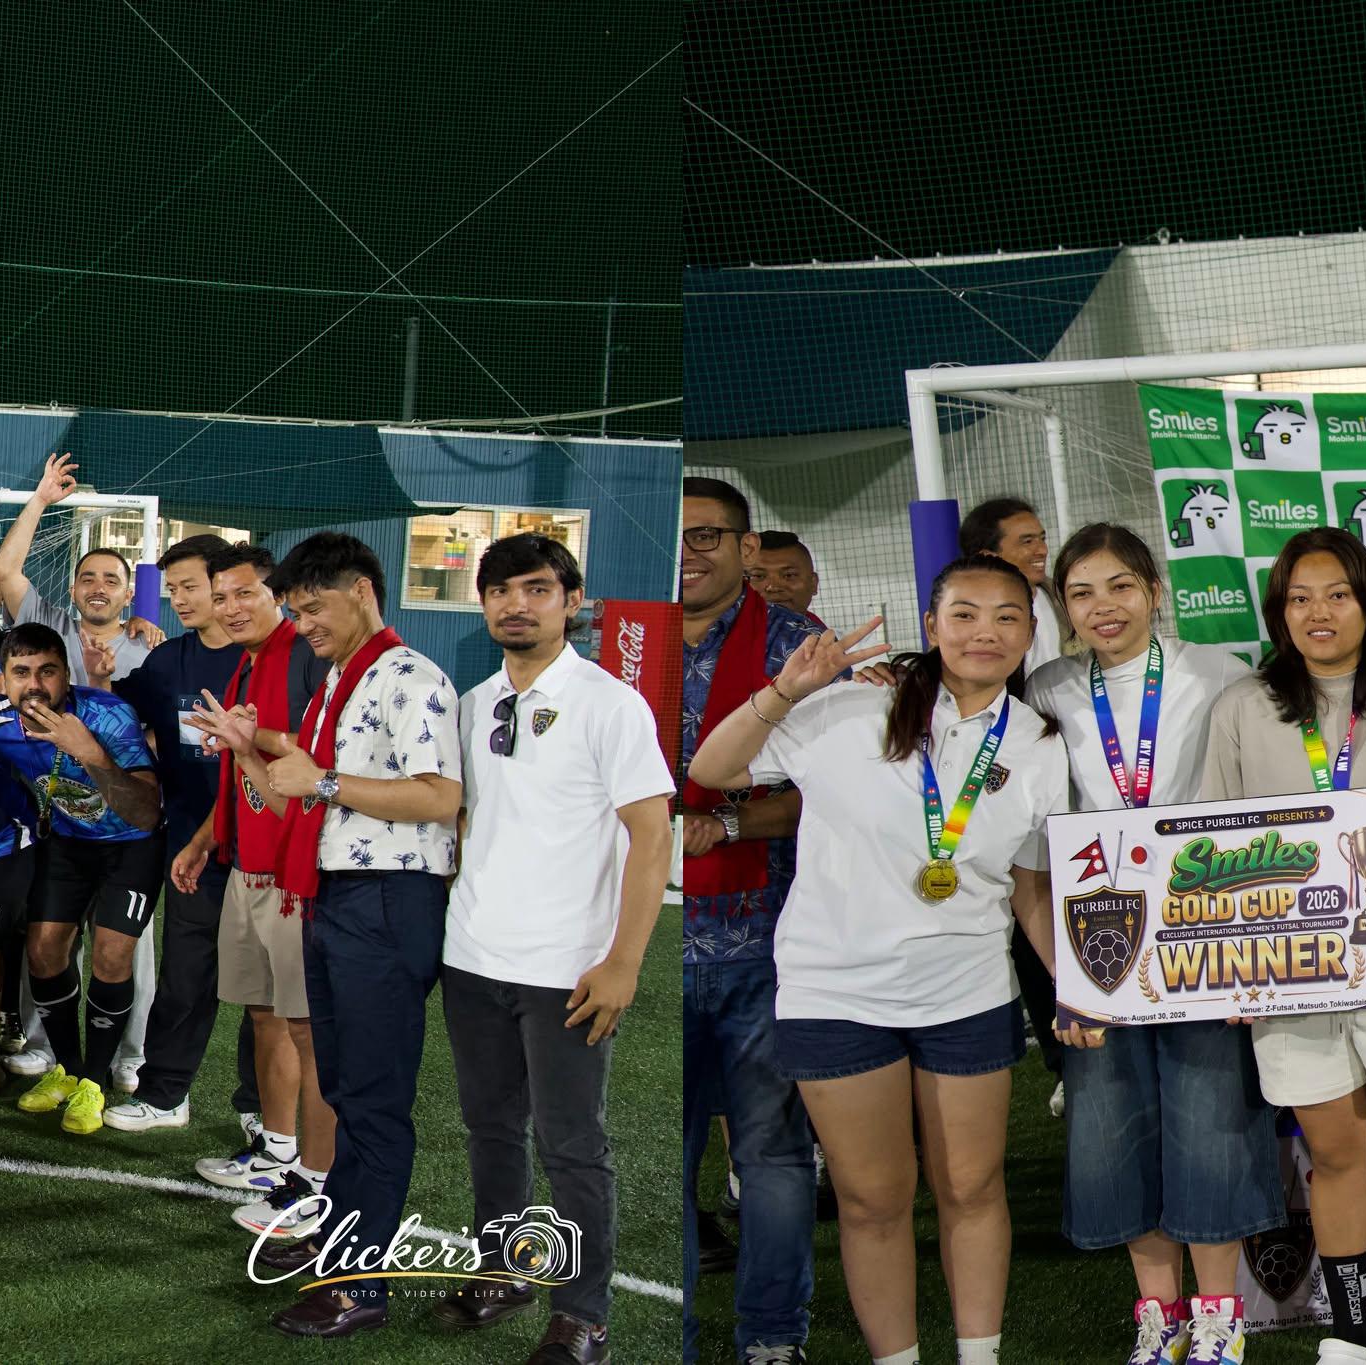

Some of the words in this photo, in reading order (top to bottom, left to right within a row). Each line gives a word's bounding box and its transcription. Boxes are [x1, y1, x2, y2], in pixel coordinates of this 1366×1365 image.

[1148, 408, 1218, 431] Smiles
[1151, 431, 1177, 439] Mobile
[1328, 435, 1355, 443] Mobile
[1248, 499, 1318, 520] Smiles
[1250, 520, 1274, 529] Mobile
[1275, 520, 1319, 529] Remittance
[1176, 585, 1246, 610] Smiles
[1179, 610, 1204, 618] Mobile
[1205, 606, 1248, 615] Remittance
[1094, 682, 1105, 698] MY
[986, 733, 1000, 752] MY
[1139, 739, 1152, 757] MY
[971, 748, 992, 780] NEPAL
[1337, 754, 1348, 771] MY
[1112, 762, 1128, 794] PRIDE
[1136, 757, 1151, 789] NEPAL
[1315, 768, 1330, 786] MY
[1176, 819, 1204, 831] SPICE
[1206, 816, 1246, 828] PURBELI
[1248, 815, 1260, 825] FC
[1267, 811, 1315, 823] PRESENTS
[1168, 830, 1321, 896] Smiles
[127, 890, 146, 921] 11
[1073, 900, 1123, 914] PURBELI
[1126, 899, 1140, 910] FC
[1162, 892, 1235, 928] GOLD
[1240, 888, 1296, 923] CUP
[1306, 890, 1339, 910] 2026
[1162, 929, 1196, 940] EXCLUSIVE
[1197, 926, 1245, 937] INTERNATIONAL
[1247, 924, 1276, 934] WOMEN'S
[1277, 922, 1300, 931] FUTSAL
[1301, 919, 1344, 929] TOURNAMENT
[1157, 932, 1349, 993] WINNER
[1131, 1013, 1156, 1022] August
[1170, 1011, 1186, 1019] 2026
[1239, 1006, 1264, 1014] Venue:
[1265, 1003, 1296, 1013] Z-Futsal,
[1297, 1001, 1328, 1009] Matsudo
[1243, 1319, 1267, 1329] Date:
[1268, 1316, 1301, 1328] August
[1317, 1311, 1333, 1321] 202
